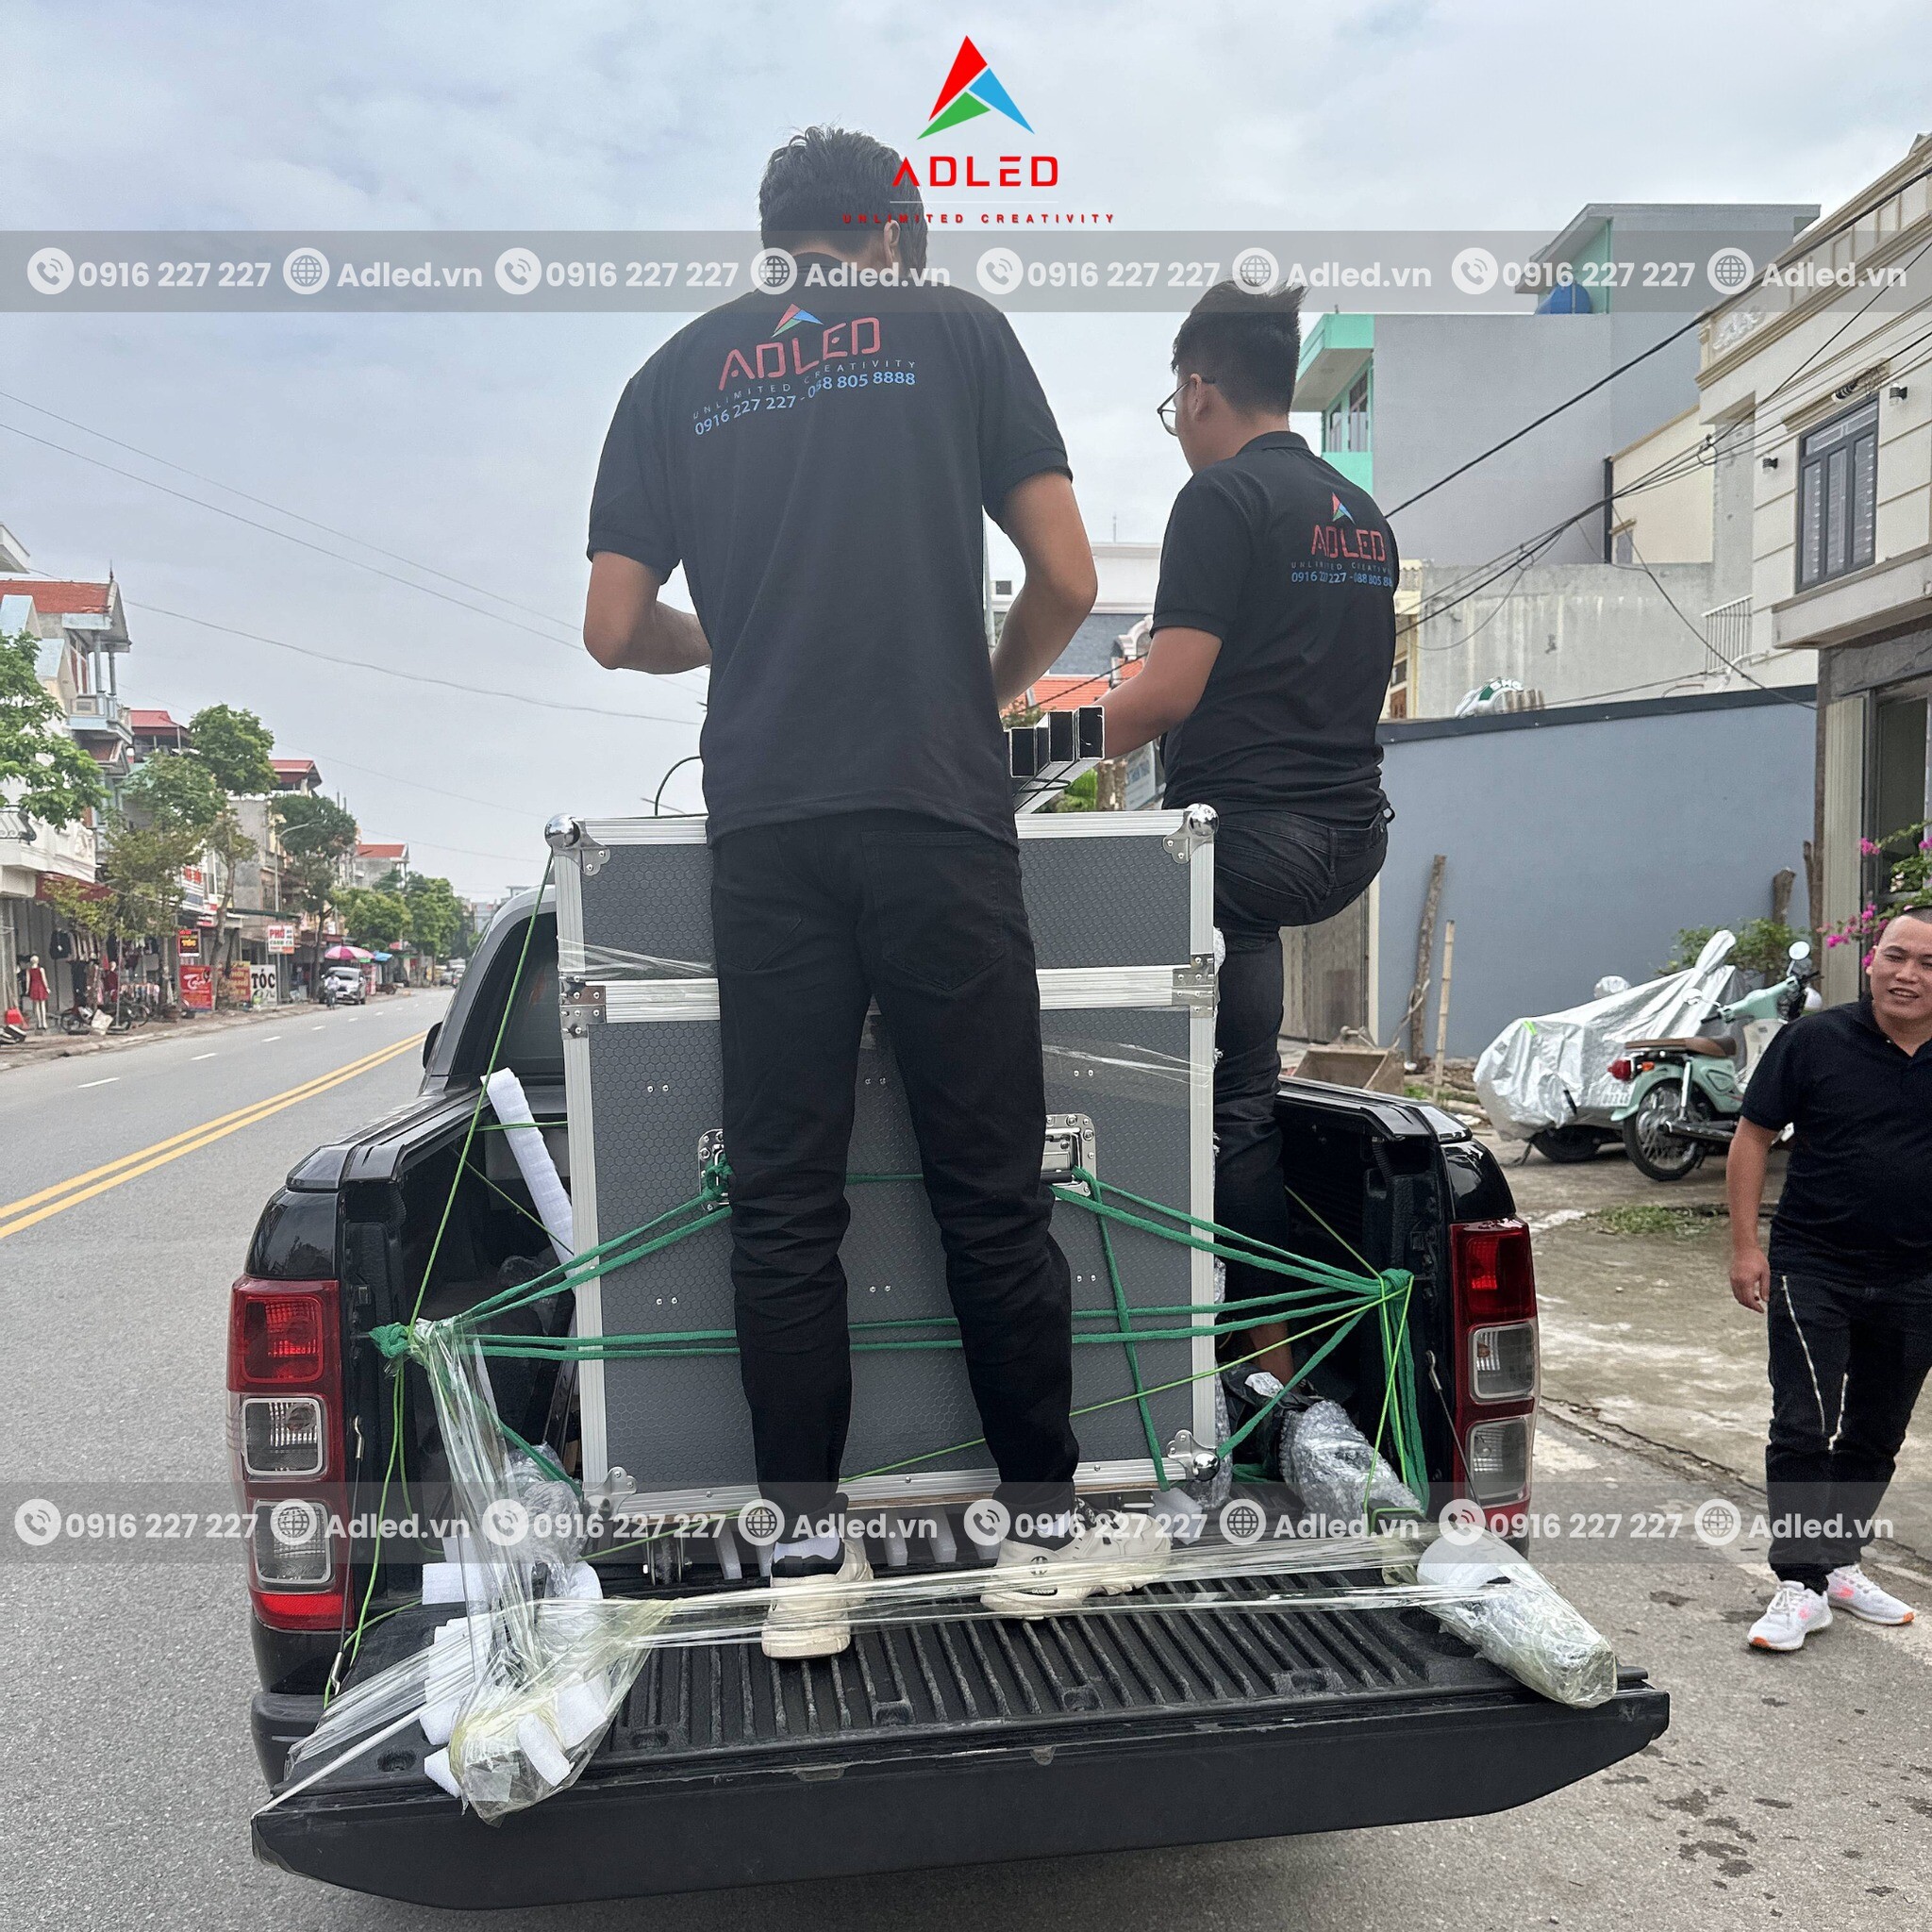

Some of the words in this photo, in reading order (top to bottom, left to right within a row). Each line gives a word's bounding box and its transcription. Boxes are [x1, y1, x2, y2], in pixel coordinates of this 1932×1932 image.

[719, 317, 881, 391] ADLED
[692, 383, 791, 420] UNLIMITED
[804, 359, 916, 385] CREATIVITY
[694, 408, 730, 436] 0916
[733, 398, 760, 419] 227
[766, 395, 796, 410] 227
[837, 374, 869, 389] 805
[873, 371, 916, 386] 8888
[1310, 525, 1386, 562] ADLED
[1291, 571, 1318, 583] 0916
[1328, 572, 1347, 584] 227
[251, 968, 275, 990] TÓC
